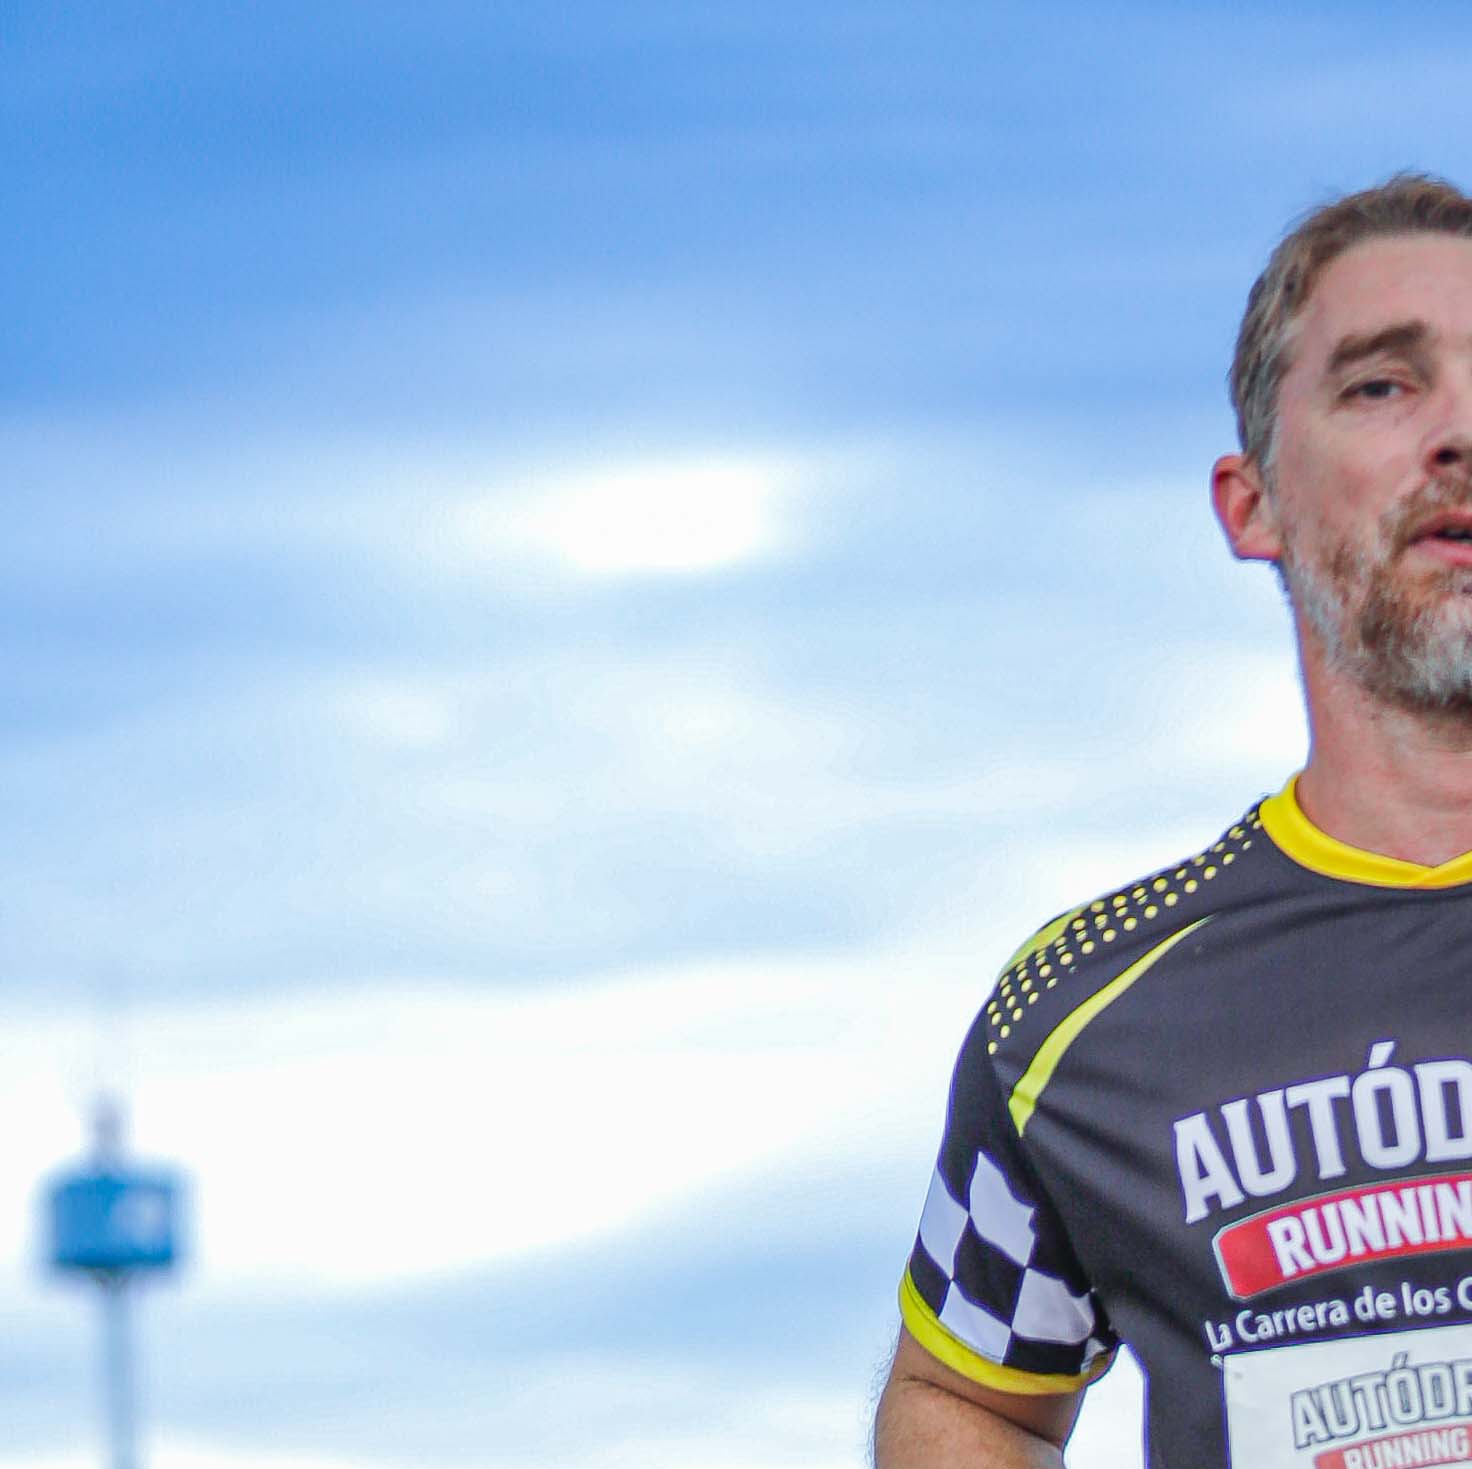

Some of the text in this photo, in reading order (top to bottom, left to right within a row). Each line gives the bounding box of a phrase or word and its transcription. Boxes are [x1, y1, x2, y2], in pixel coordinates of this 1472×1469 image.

[1235, 1300, 1350, 1343] Carrera
[1355, 1286, 1394, 1319] de
[1401, 1283, 1450, 1316] los
